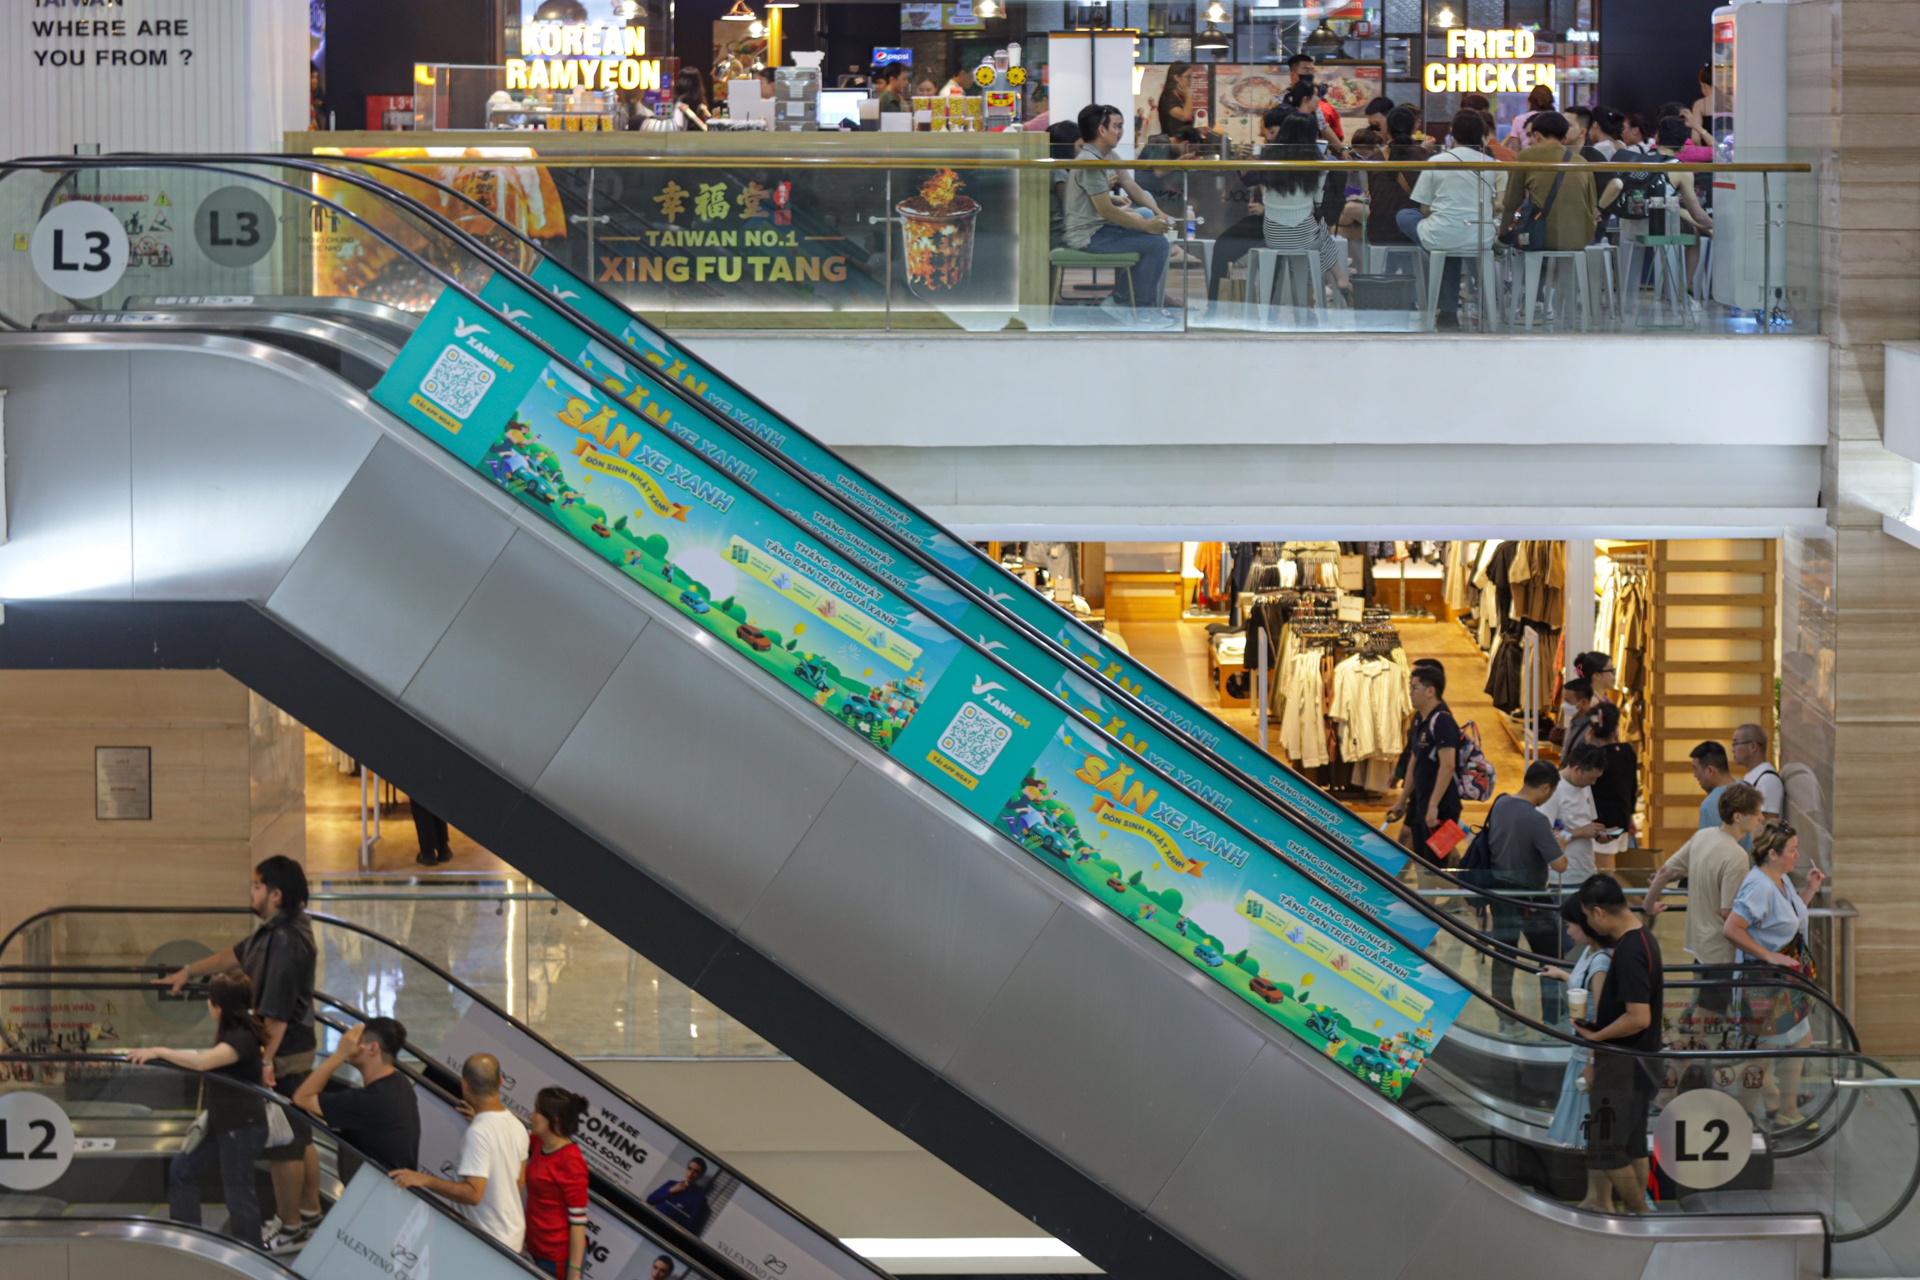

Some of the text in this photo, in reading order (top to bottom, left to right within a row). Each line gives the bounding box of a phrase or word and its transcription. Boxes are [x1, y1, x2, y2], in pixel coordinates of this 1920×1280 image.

[32, 20, 189, 37] WHERE ARE
[521, 25, 646, 55] KOREAN
[1447, 29, 1535, 58] FRIED
[34, 50, 193, 66] YOU FROM ?
[505, 58, 661, 90] RAMYEON
[887, 53, 909, 61] pepsi
[1424, 62, 1556, 93] CHICKEN
[653, 180, 770, 223] 幸福堂
[208, 210, 260, 247] L3
[645, 230, 799, 247] TAIWAN NO.1
[53, 229, 111, 272] L3
[599, 256, 847, 282] XING FU TANG
[558, 397, 735, 513] SĂN XE XANH
[606, 464, 628, 476] SINH
[648, 493, 670, 513] XANH
[836, 474, 867, 497] THÁNG
[866, 493, 886, 510] SINH
[813, 511, 846, 537] THÁNG
[845, 531, 867, 550] SINH
[899, 526, 924, 548] XANH
[795, 541, 884, 602] THÁNG SINH NHẬT
[880, 569, 908, 591] XANH
[867, 604, 898, 627] XANH
[1269, 775, 1299, 798] THÁNG
[1298, 794, 1318, 811] SINH
[1075, 755, 1250, 868] SĂN XE XANH
[1123, 819, 1145, 832] SINH
[1165, 849, 1185, 869] XANH
[1330, 827, 1354, 847] XANH
[1287, 840, 1319, 864] THÁNG
[1318, 860, 1341, 878] SINH
[1353, 894, 1379, 917] XANH
[1309, 897, 1343, 922] THÁNG
[1343, 919, 1367, 938] SINH
[1367, 933, 1396, 954] NHẬT
[1306, 912, 1329, 930] BẠN
[1380, 957, 1410, 980] XANH
[0, 1118, 58, 1160] L2
[601, 1107, 641, 1139] WE ARE
[1675, 1119, 1730, 1161] L2
[578, 1132, 600, 1151] ACK
[336, 1228, 395, 1274] VALENTINO
[717, 1241, 768, 1280] VALENTINO
